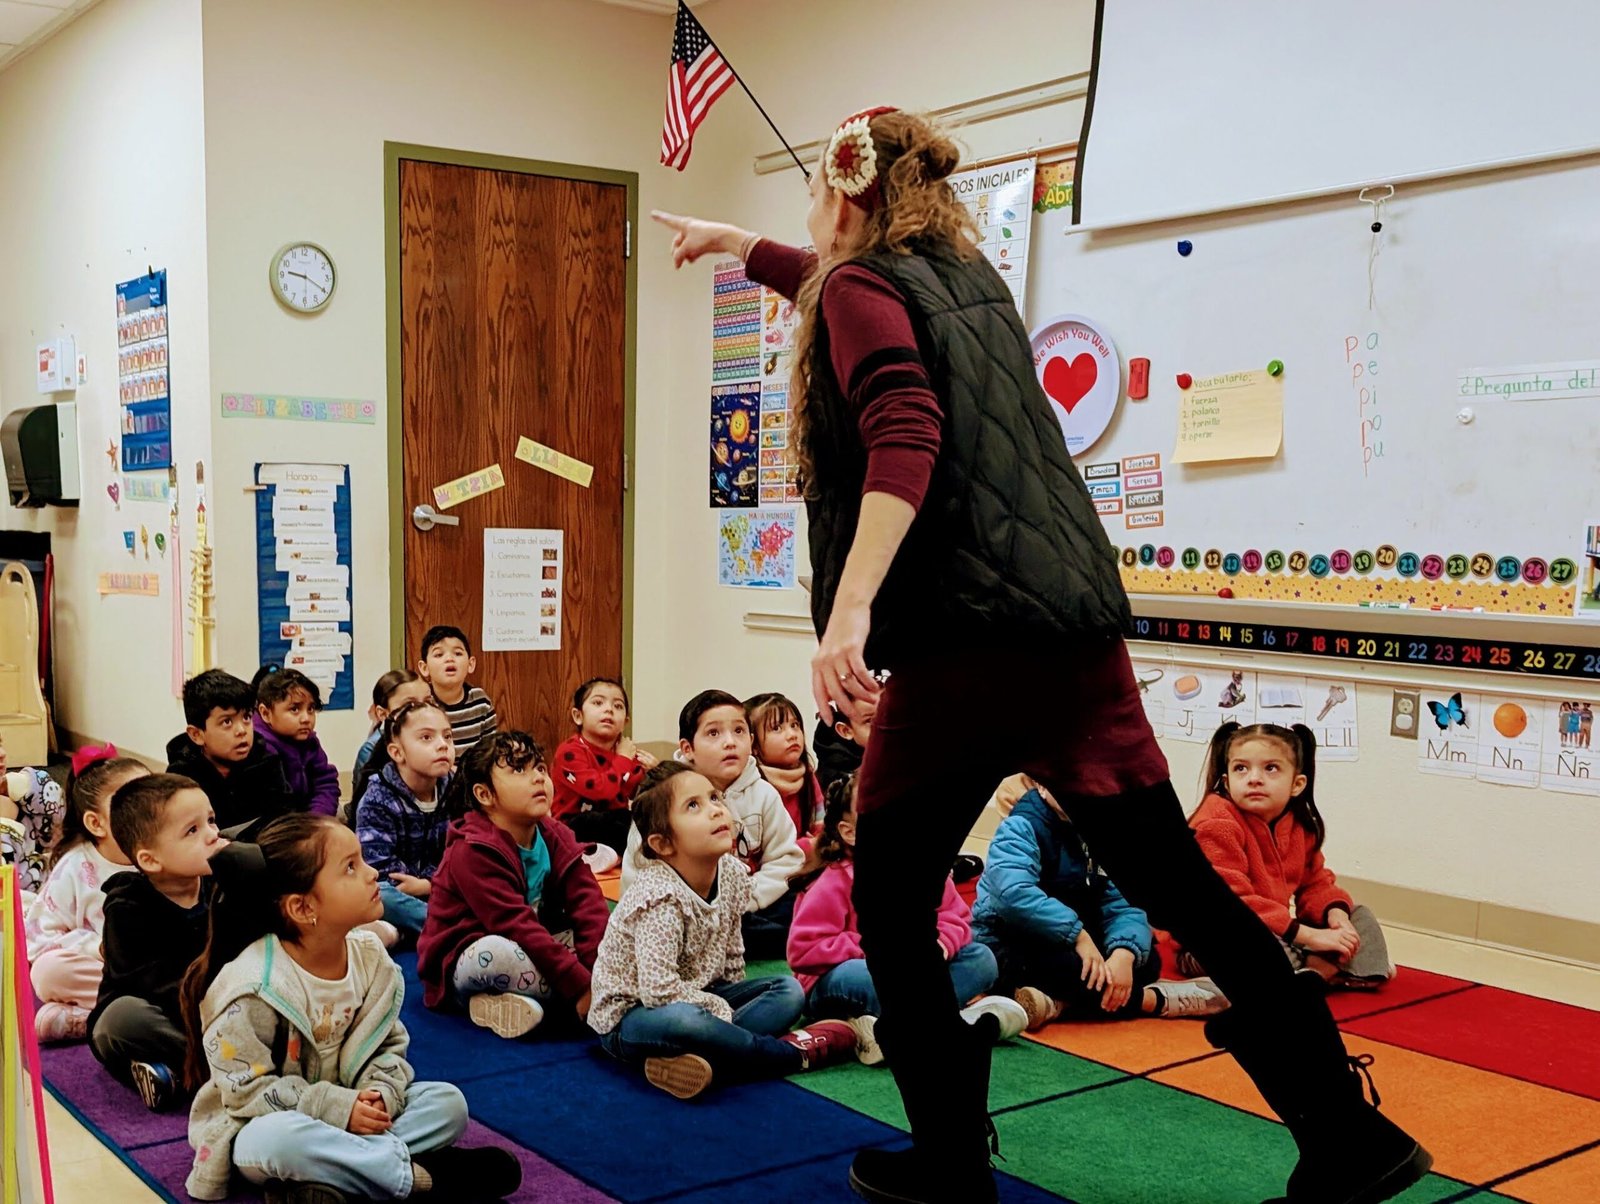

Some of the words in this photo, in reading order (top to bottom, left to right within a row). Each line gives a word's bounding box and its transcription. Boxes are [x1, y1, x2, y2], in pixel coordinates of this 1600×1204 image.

[976, 168, 1029, 190] INICIALES
[1045, 330, 1069, 349] Wish
[1072, 328, 1090, 341] You
[1091, 334, 1110, 358] Well
[1568, 370, 1595, 390] del
[242, 394, 356, 420] ELIZABETH
[286, 471, 318, 480] Horario
[493, 536, 505, 544] Las
[506, 537, 526, 547] reglas
[1126, 552, 1132, 563] 8
[1144, 549, 1150, 560] 9
[1160, 551, 1170, 564] 10
[1186, 553, 1195, 564] 11
[1208, 554, 1218, 566] 12
[1227, 560, 1237, 570] 13
[1247, 556, 1257, 567] 14
[1268, 555, 1280, 568] 15
[1291, 555, 1303, 569] 16
[1312, 559, 1326, 572] 17
[1335, 556, 1347, 567] 18
[1356, 555, 1369, 569] 19
[1380, 550, 1394, 563] 20
[1401, 559, 1414, 571] 21
[1425, 560, 1440, 575] 22
[1450, 560, 1464, 573] 23
[1474, 558, 1490, 574] 24
[1500, 562, 1515, 575] 25
[1527, 564, 1542, 577] 26
[1553, 564, 1570, 578] 27
[1136, 620, 1149, 634] 10
[1158, 622, 1168, 636] 11
[1178, 623, 1190, 637] 12
[1198, 625, 1210, 639] 13
[1219, 626, 1231, 642] 14
[1240, 628, 1253, 643] 15
[1263, 630, 1276, 645] 16
[1286, 632, 1298, 647] 17
[1312, 636, 1326, 652] 18
[1336, 638, 1349, 654] 19
[1357, 639, 1376, 656] 20
[1384, 641, 1400, 658] 21
[1408, 643, 1428, 659] 22
[1435, 645, 1454, 660] 23
[1462, 646, 1482, 663] 24
[1490, 647, 1511, 665] 25
[1523, 650, 1545, 668] 26
[1553, 652, 1576, 670] 27
[1427, 739, 1467, 763] Mm
[1492, 746, 1523, 770] Nn
[1557, 750, 1591, 778] Ññ
